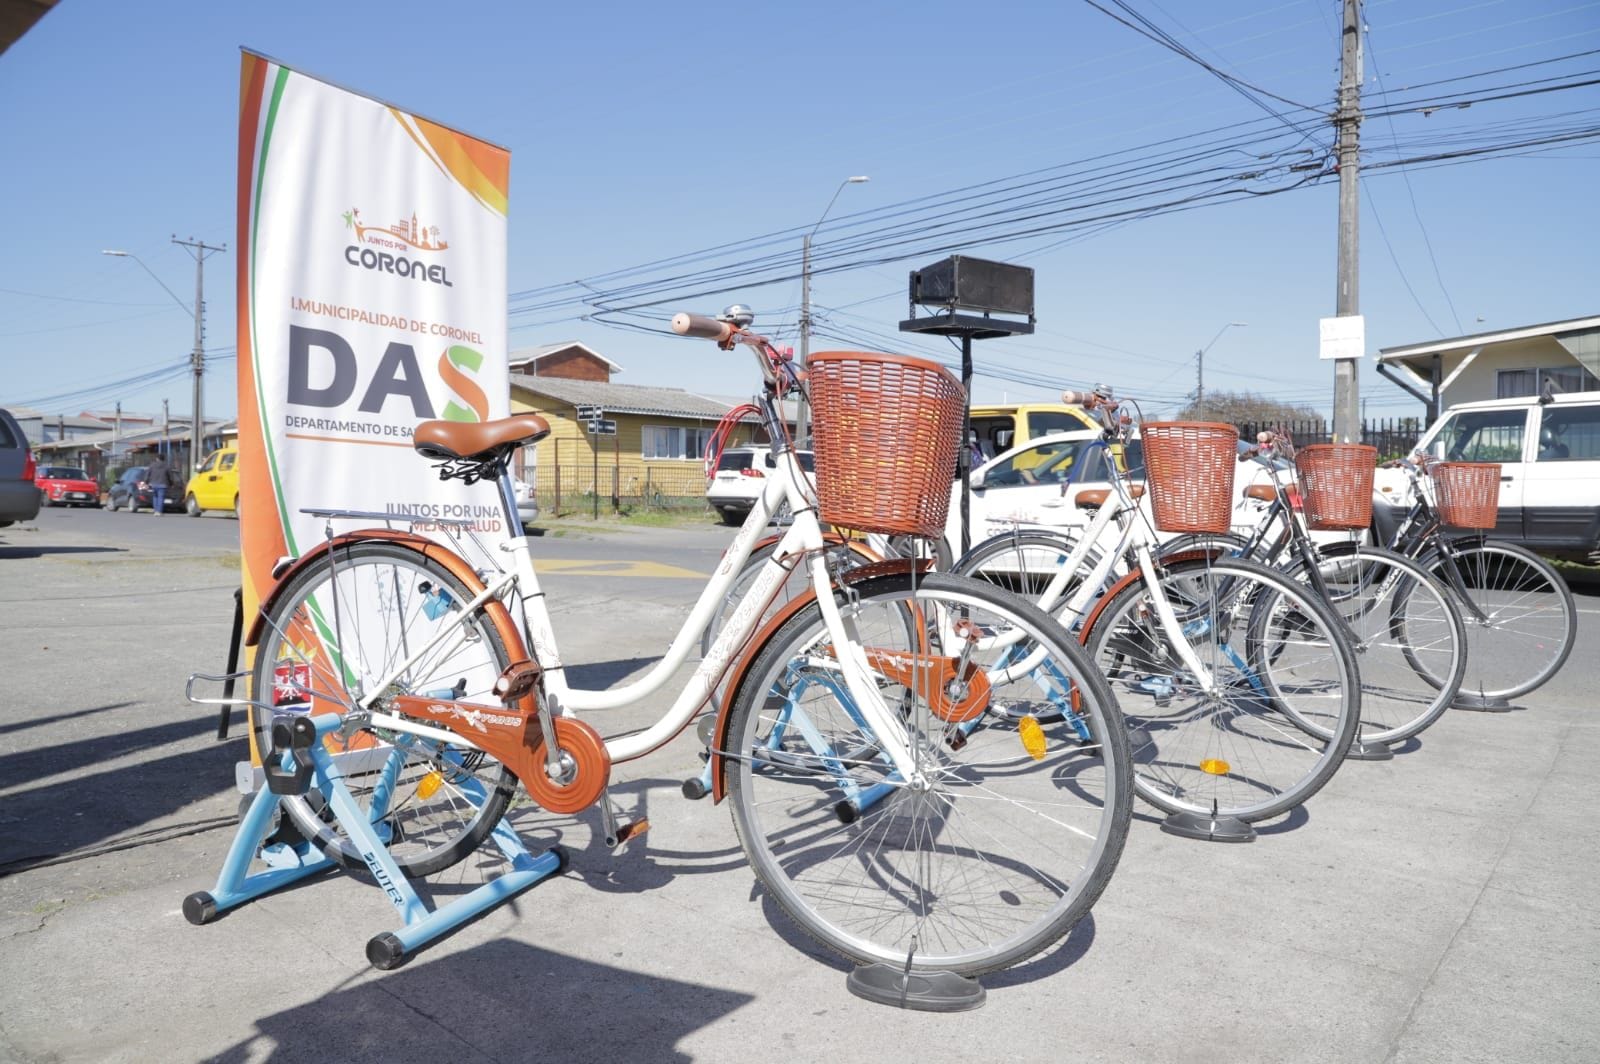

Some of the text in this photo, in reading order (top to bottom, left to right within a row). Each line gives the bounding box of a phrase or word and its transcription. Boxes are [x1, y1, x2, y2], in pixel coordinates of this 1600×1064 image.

[367, 236, 408, 252] JUNTOS POR
[344, 245, 453, 288] CORONEL
[291, 296, 484, 345] I.MUNICIPALIDAD DE CORONEL
[286, 324, 490, 424] DAS
[285, 415, 382, 435] DEPARTAMENTO
[384, 425, 399, 436] DE
[443, 504, 472, 518] POR
[474, 505, 501, 518] UNA
